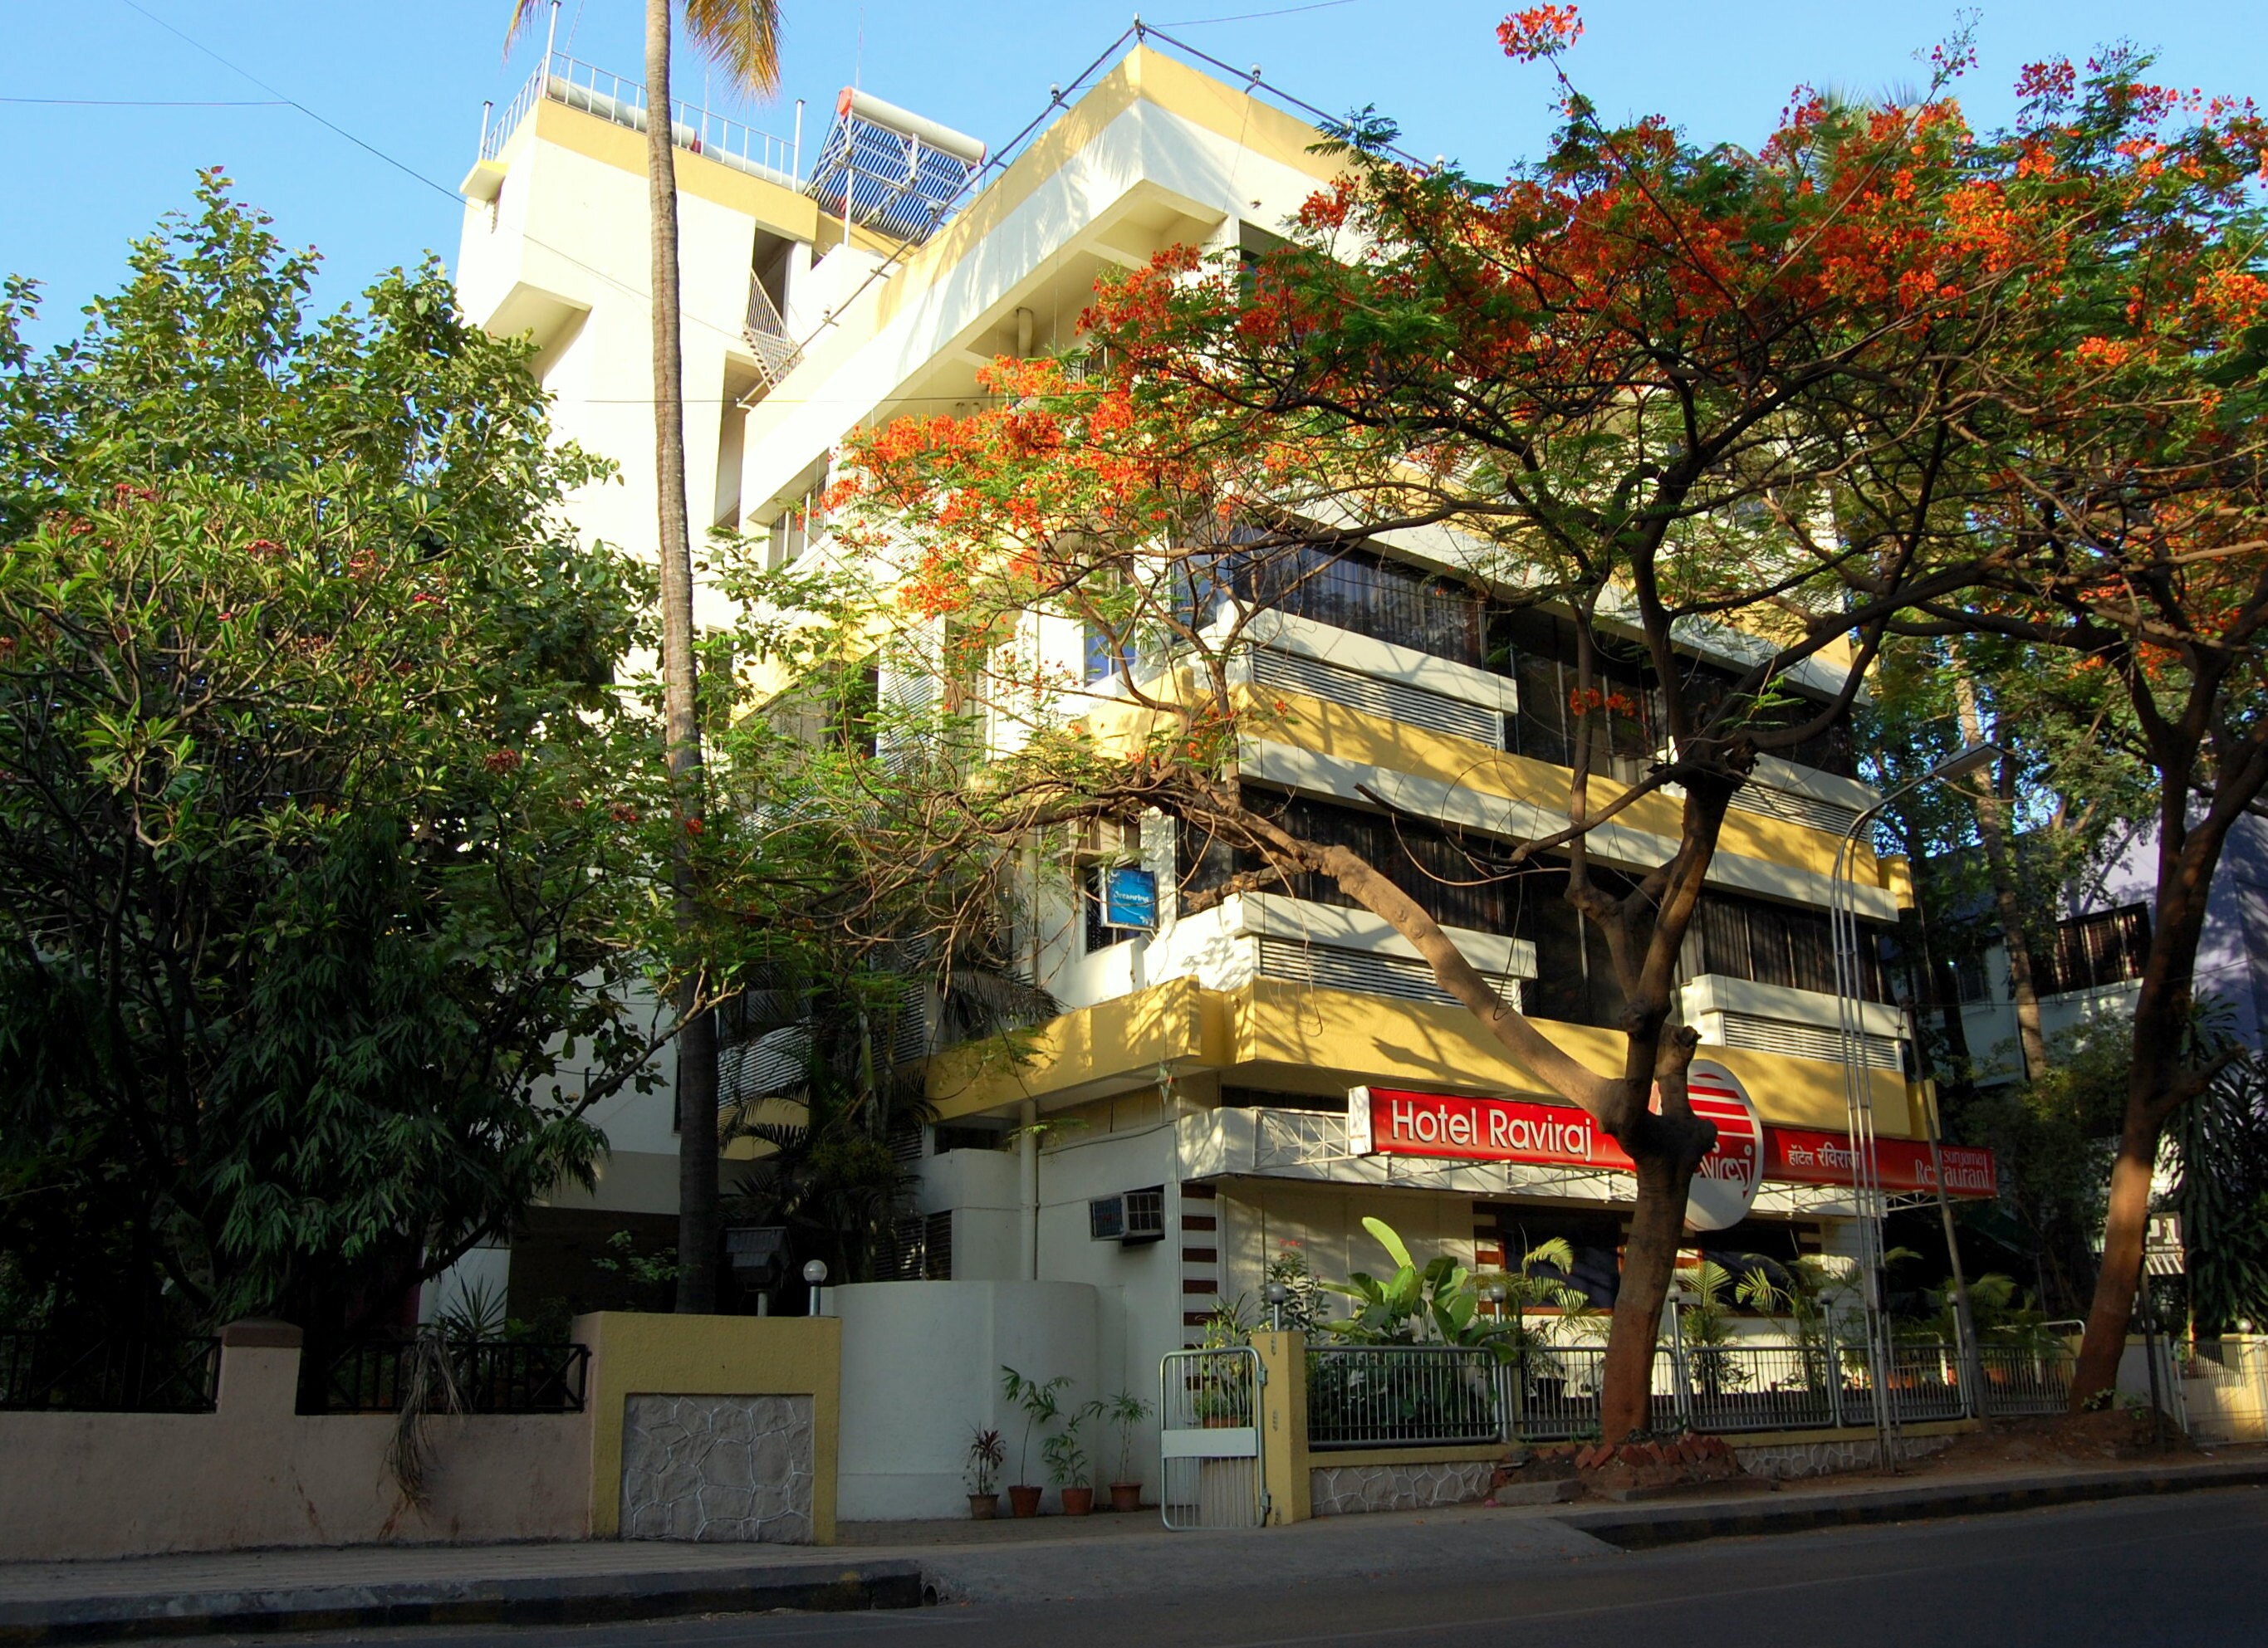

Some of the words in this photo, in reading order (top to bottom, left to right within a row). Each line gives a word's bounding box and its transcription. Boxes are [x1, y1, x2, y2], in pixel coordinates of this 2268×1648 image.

[1392, 1100, 1478, 1146] Hotel
[1489, 1108, 1592, 1162] Raviraj
[1787, 1144, 1814, 1166] हॉटेल
